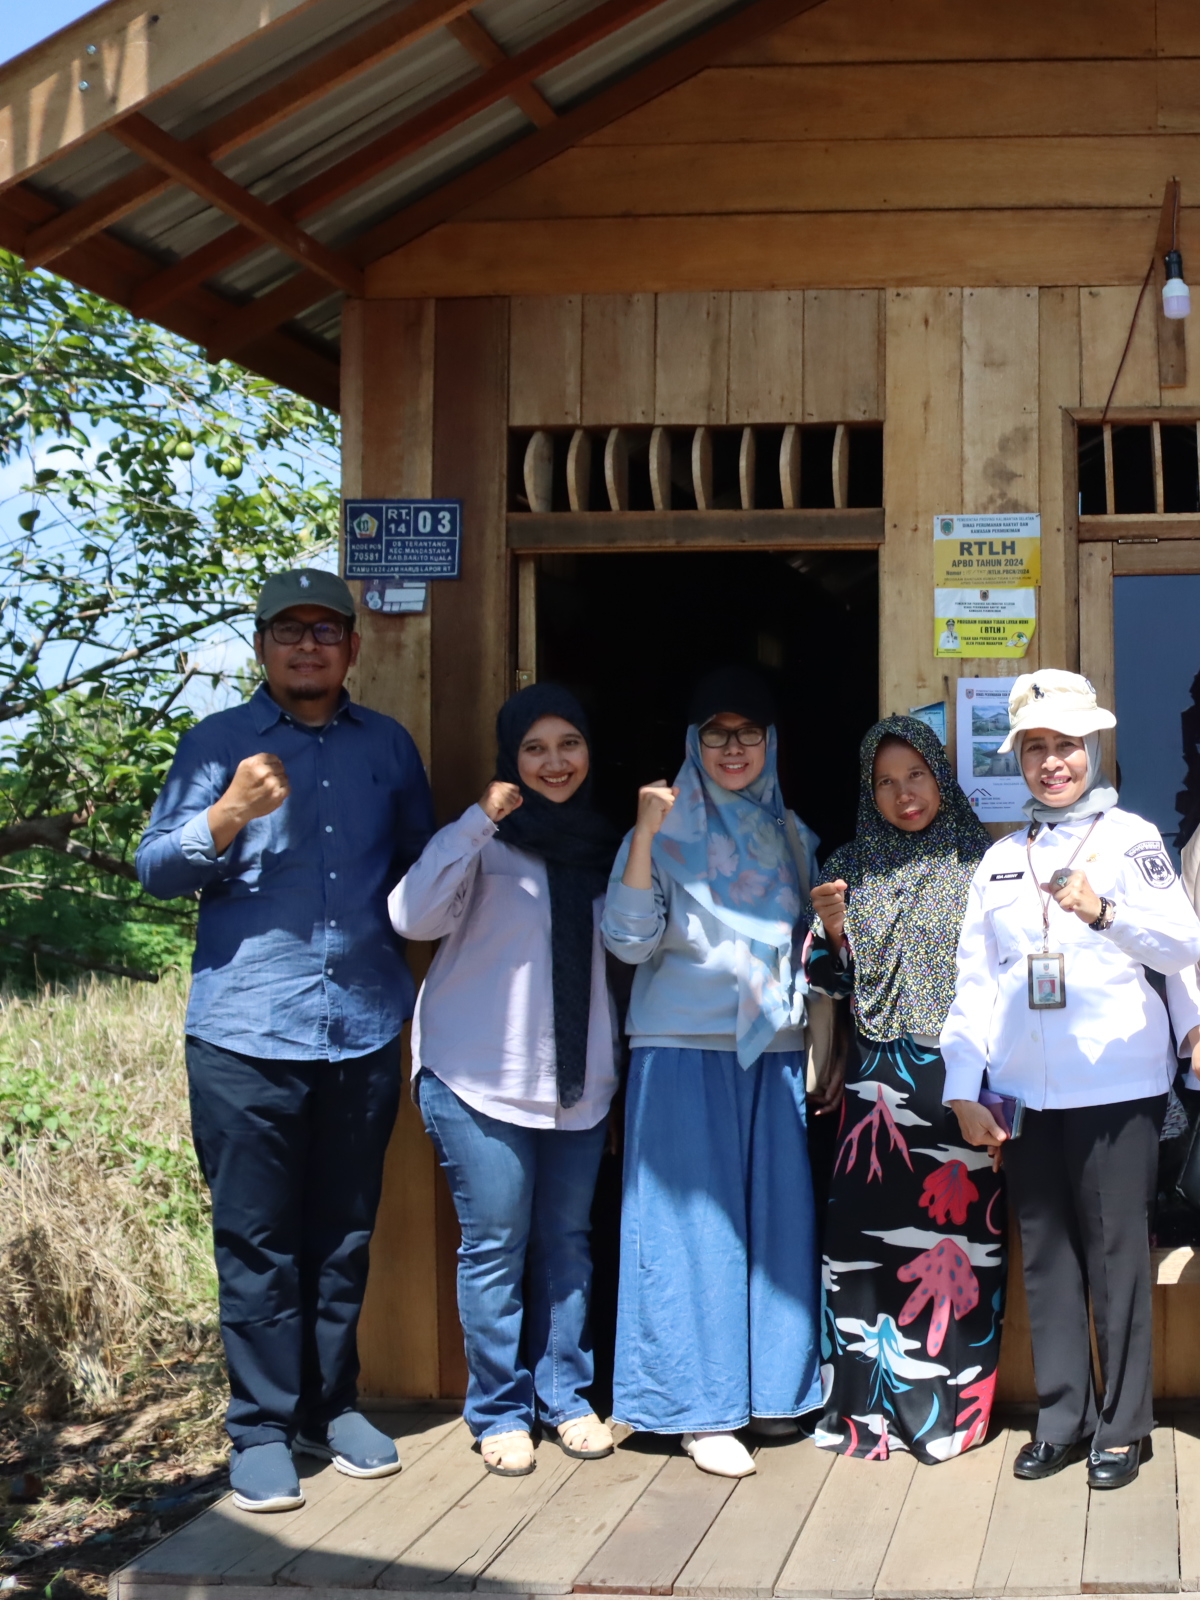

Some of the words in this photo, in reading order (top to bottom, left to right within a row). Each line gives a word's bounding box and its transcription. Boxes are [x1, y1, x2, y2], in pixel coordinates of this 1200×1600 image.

[388, 509, 410, 519] RT.
[418, 511, 451, 533] 03
[389, 524, 406, 534] 14
[960, 541, 1015, 556] RTLH
